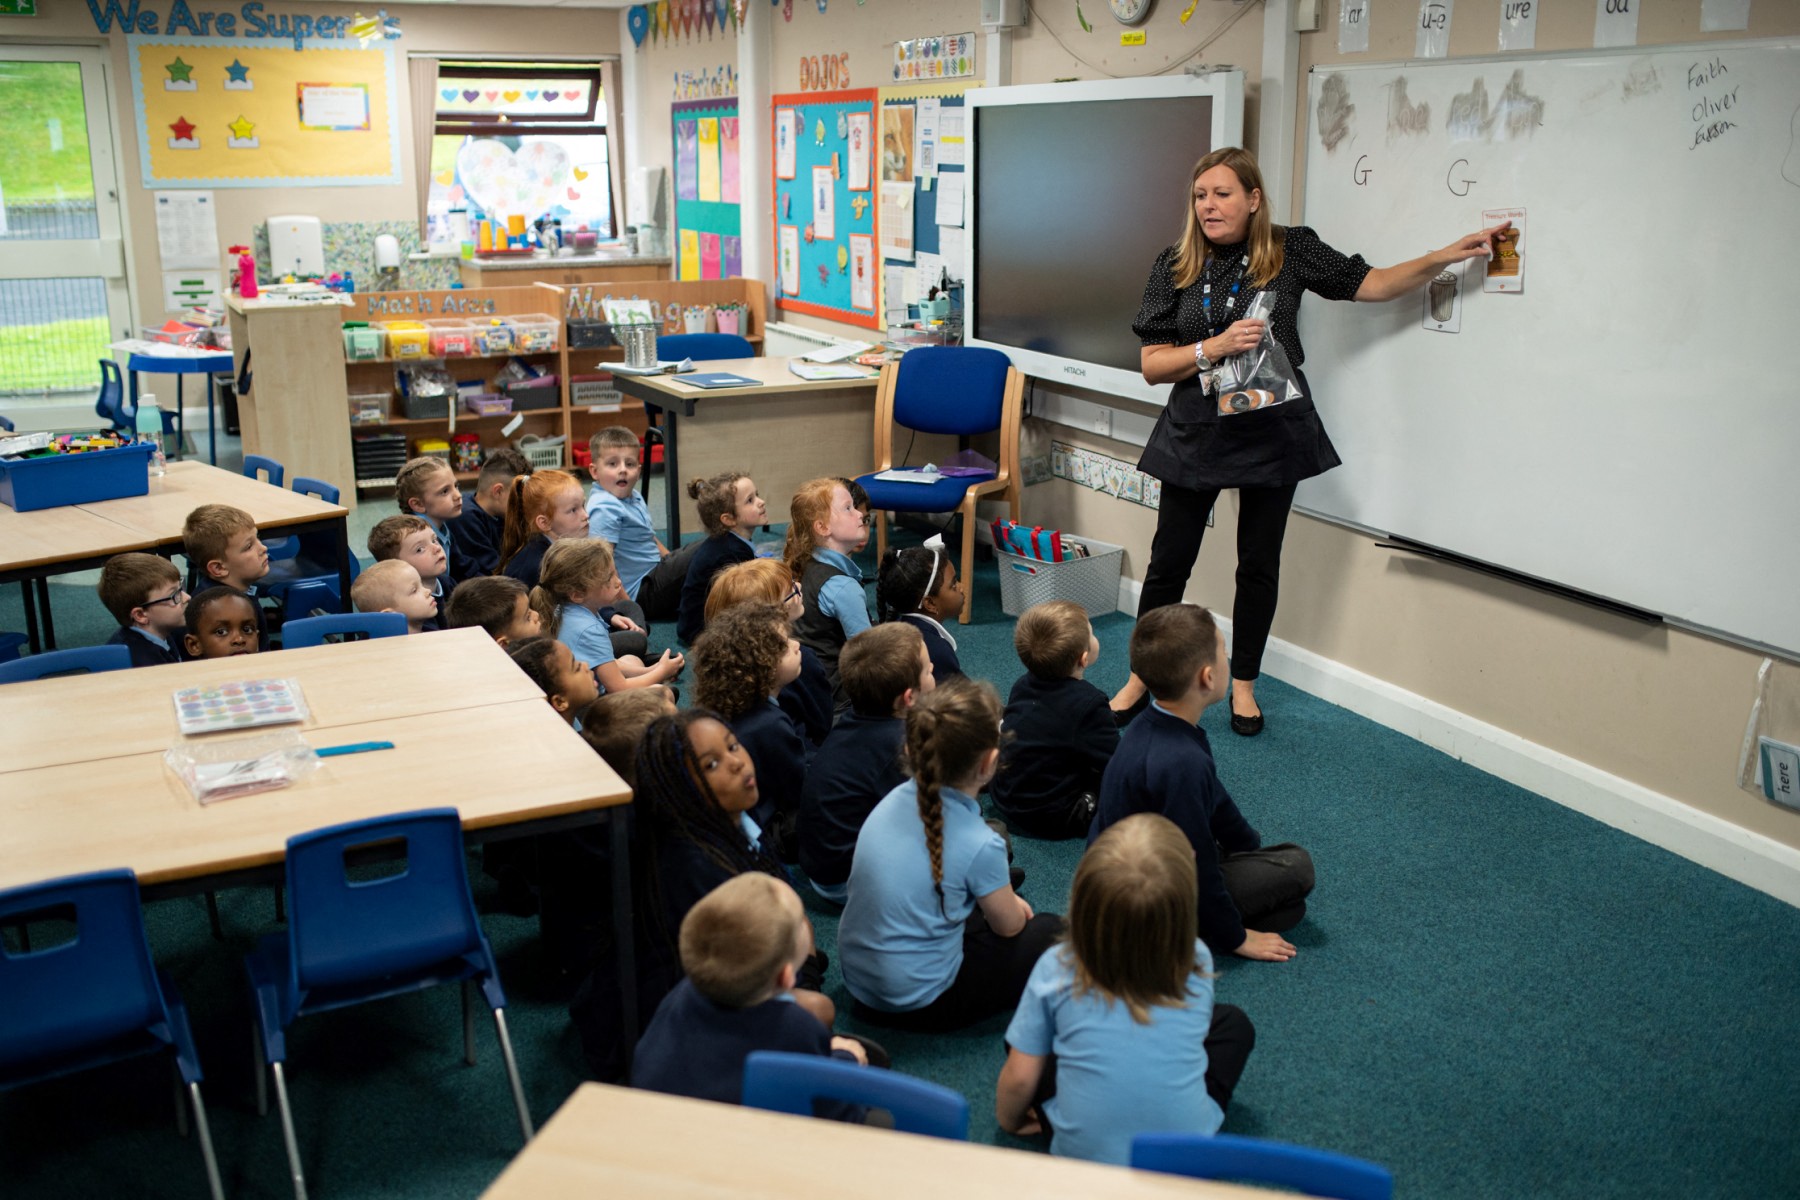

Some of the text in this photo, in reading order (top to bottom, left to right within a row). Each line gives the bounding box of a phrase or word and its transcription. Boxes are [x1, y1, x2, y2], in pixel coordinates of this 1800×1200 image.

[88, 0, 159, 34] We
[166, 0, 236, 36] Are
[1348, 8, 1363, 24] ar
[1505, 1, 1531, 20] ure
[800, 52, 850, 91] DOJOS
[1687, 57, 1728, 91] Faith
[1692, 84, 1740, 122] Oliver
[1353, 154, 1373, 186] G
[1446, 158, 1478, 197] G
[367, 294, 496, 315] Math Area
[1064, 366, 1086, 376] HITACHI
[1777, 761, 1791, 795] here
